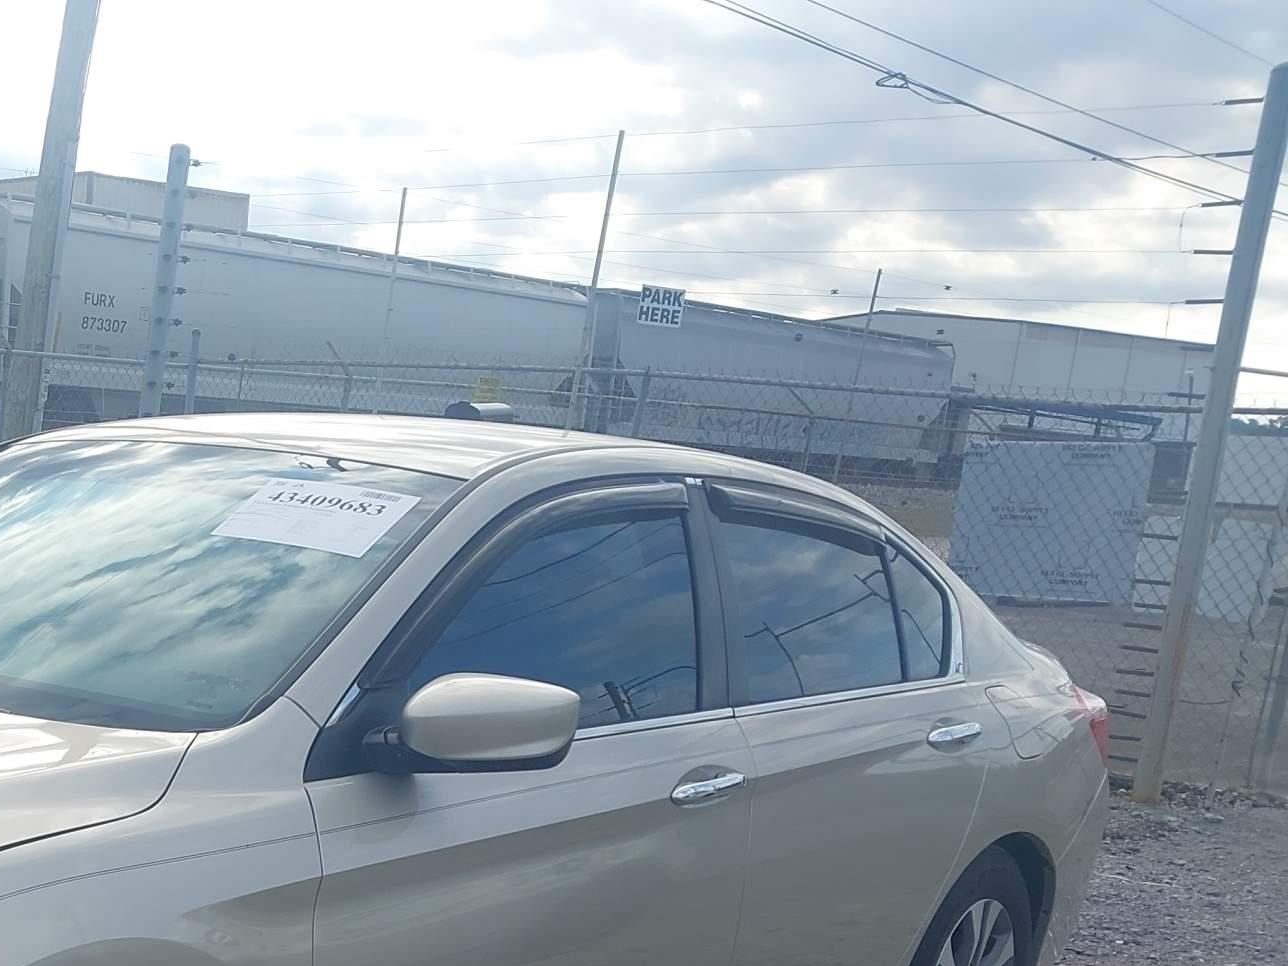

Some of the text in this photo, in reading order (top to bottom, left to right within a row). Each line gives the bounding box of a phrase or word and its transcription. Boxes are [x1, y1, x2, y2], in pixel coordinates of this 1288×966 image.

[84, 292, 116, 309] FURX
[641, 287, 685, 307] PARK
[81, 316, 128, 334] 873307
[638, 306, 681, 325] HERE
[268, 491, 386, 516] 43409683
